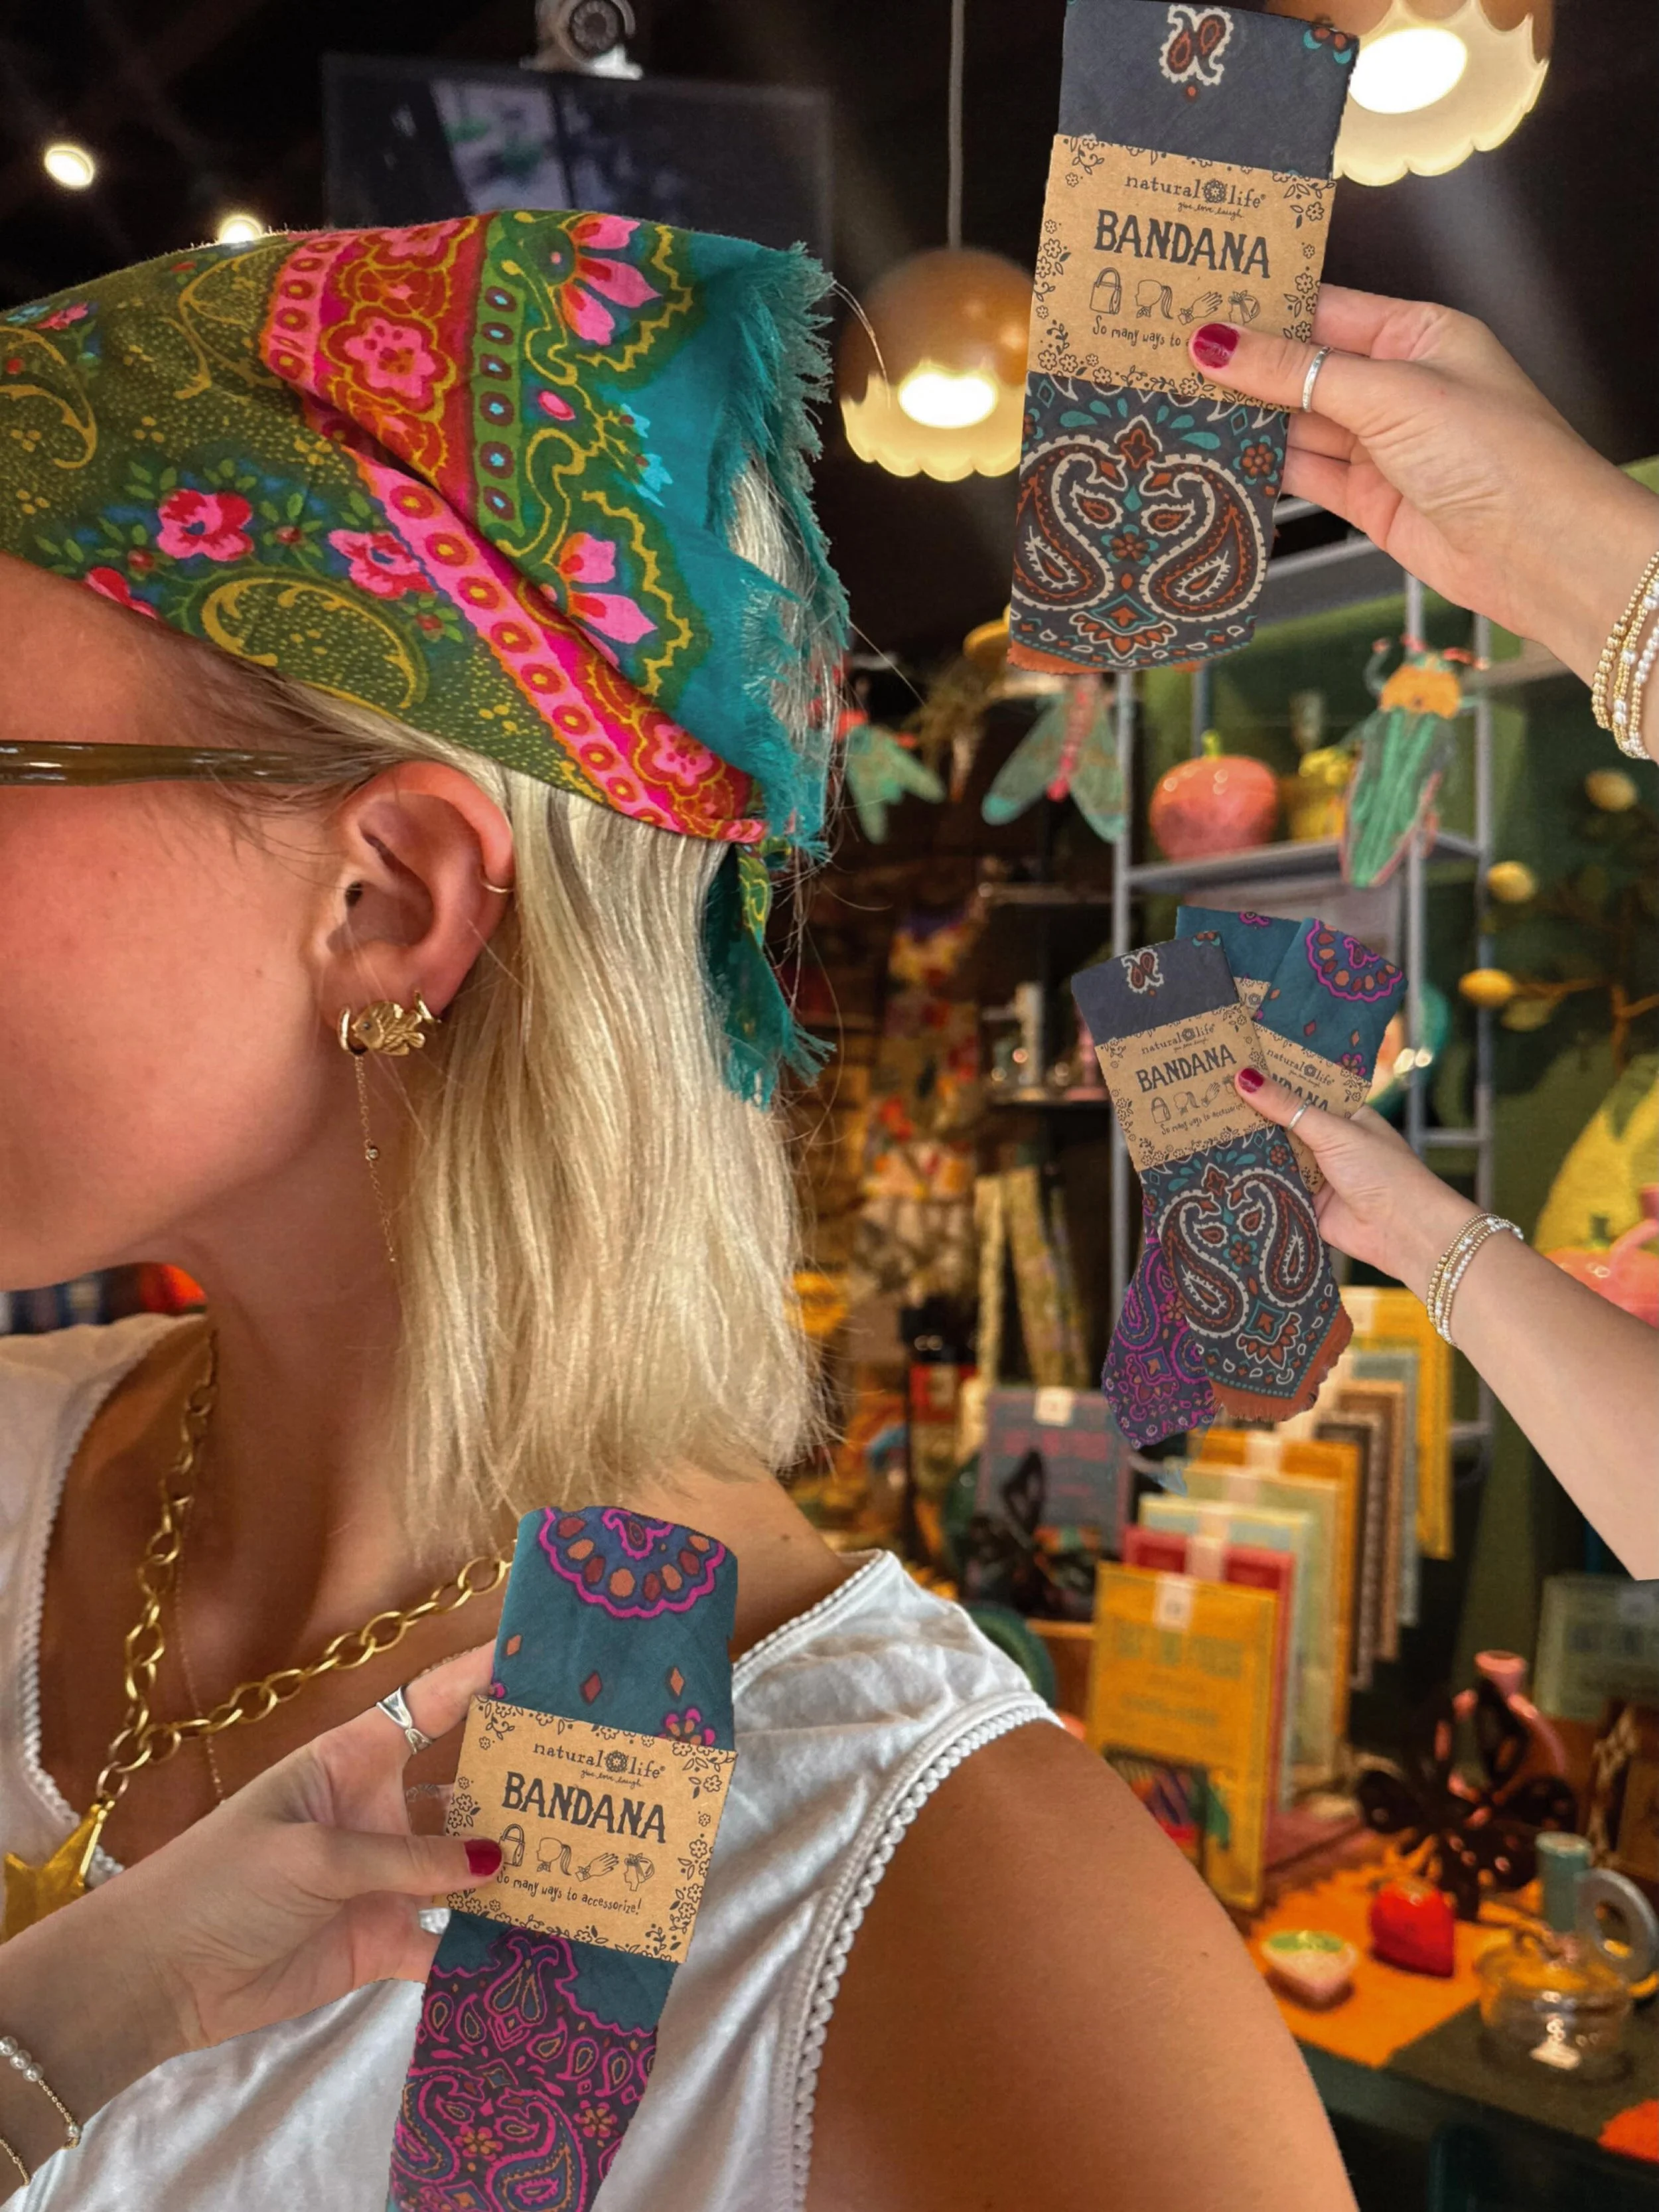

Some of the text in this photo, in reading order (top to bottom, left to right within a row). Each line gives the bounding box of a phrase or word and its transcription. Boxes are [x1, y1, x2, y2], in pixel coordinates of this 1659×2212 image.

[1125, 175, 1201, 199] natural
[1093, 209, 1271, 279] BANDANA
[1092, 315, 1108, 334] So
[1111, 328, 1139, 346] many
[1170, 332, 1181, 347] to
[1141, 1032, 1183, 1055] natural
[1135, 1043, 1238, 1093] BANDANA
[1266, 1049, 1305, 1071] natural
[532, 1743, 604, 1768] natural
[501, 1771, 666, 1844] BANDANA
[513, 1879, 539, 1897] many
[567, 1887, 578, 1901] to
[581, 1895, 642, 1915] accessorize!
